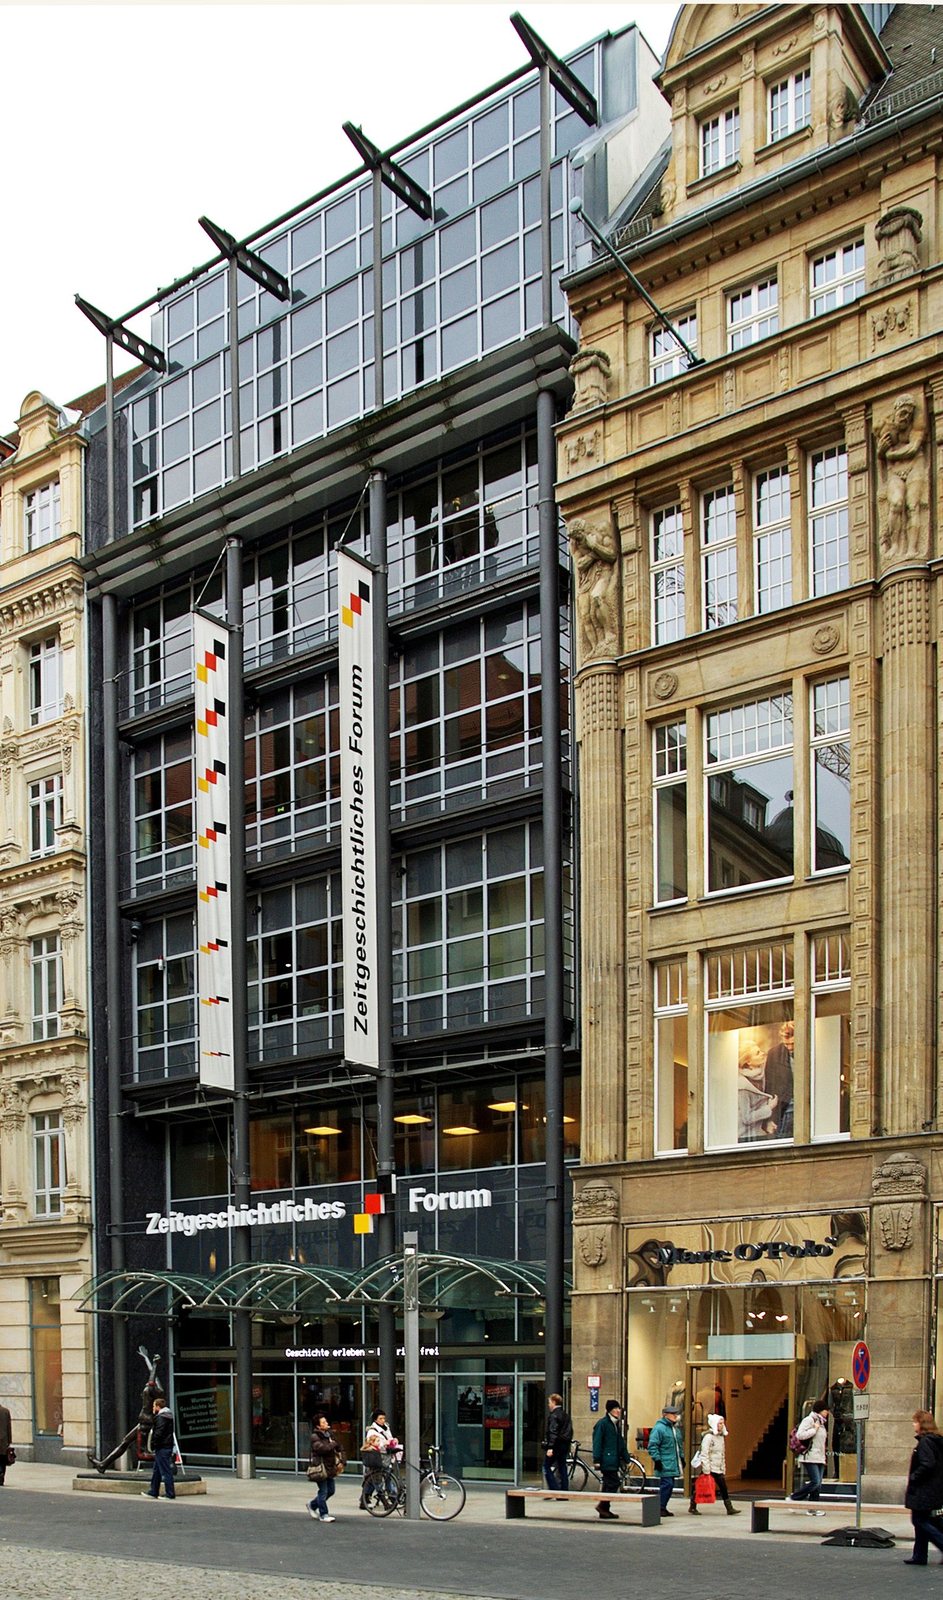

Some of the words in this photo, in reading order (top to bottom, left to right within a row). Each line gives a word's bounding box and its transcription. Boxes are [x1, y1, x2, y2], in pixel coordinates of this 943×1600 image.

[349, 663, 363, 756] Forum
[350, 764, 371, 1036] Zeitgeschichtliches
[145, 1198, 346, 1236] Zeitgeschichtliches
[408, 1187, 492, 1212] Forum
[659, 1248, 732, 1265] Marc
[285, 1348, 329, 1357] Geschichte
[332, 1348, 365, 1357] erleben
[420, 1346, 439, 1355] frei
